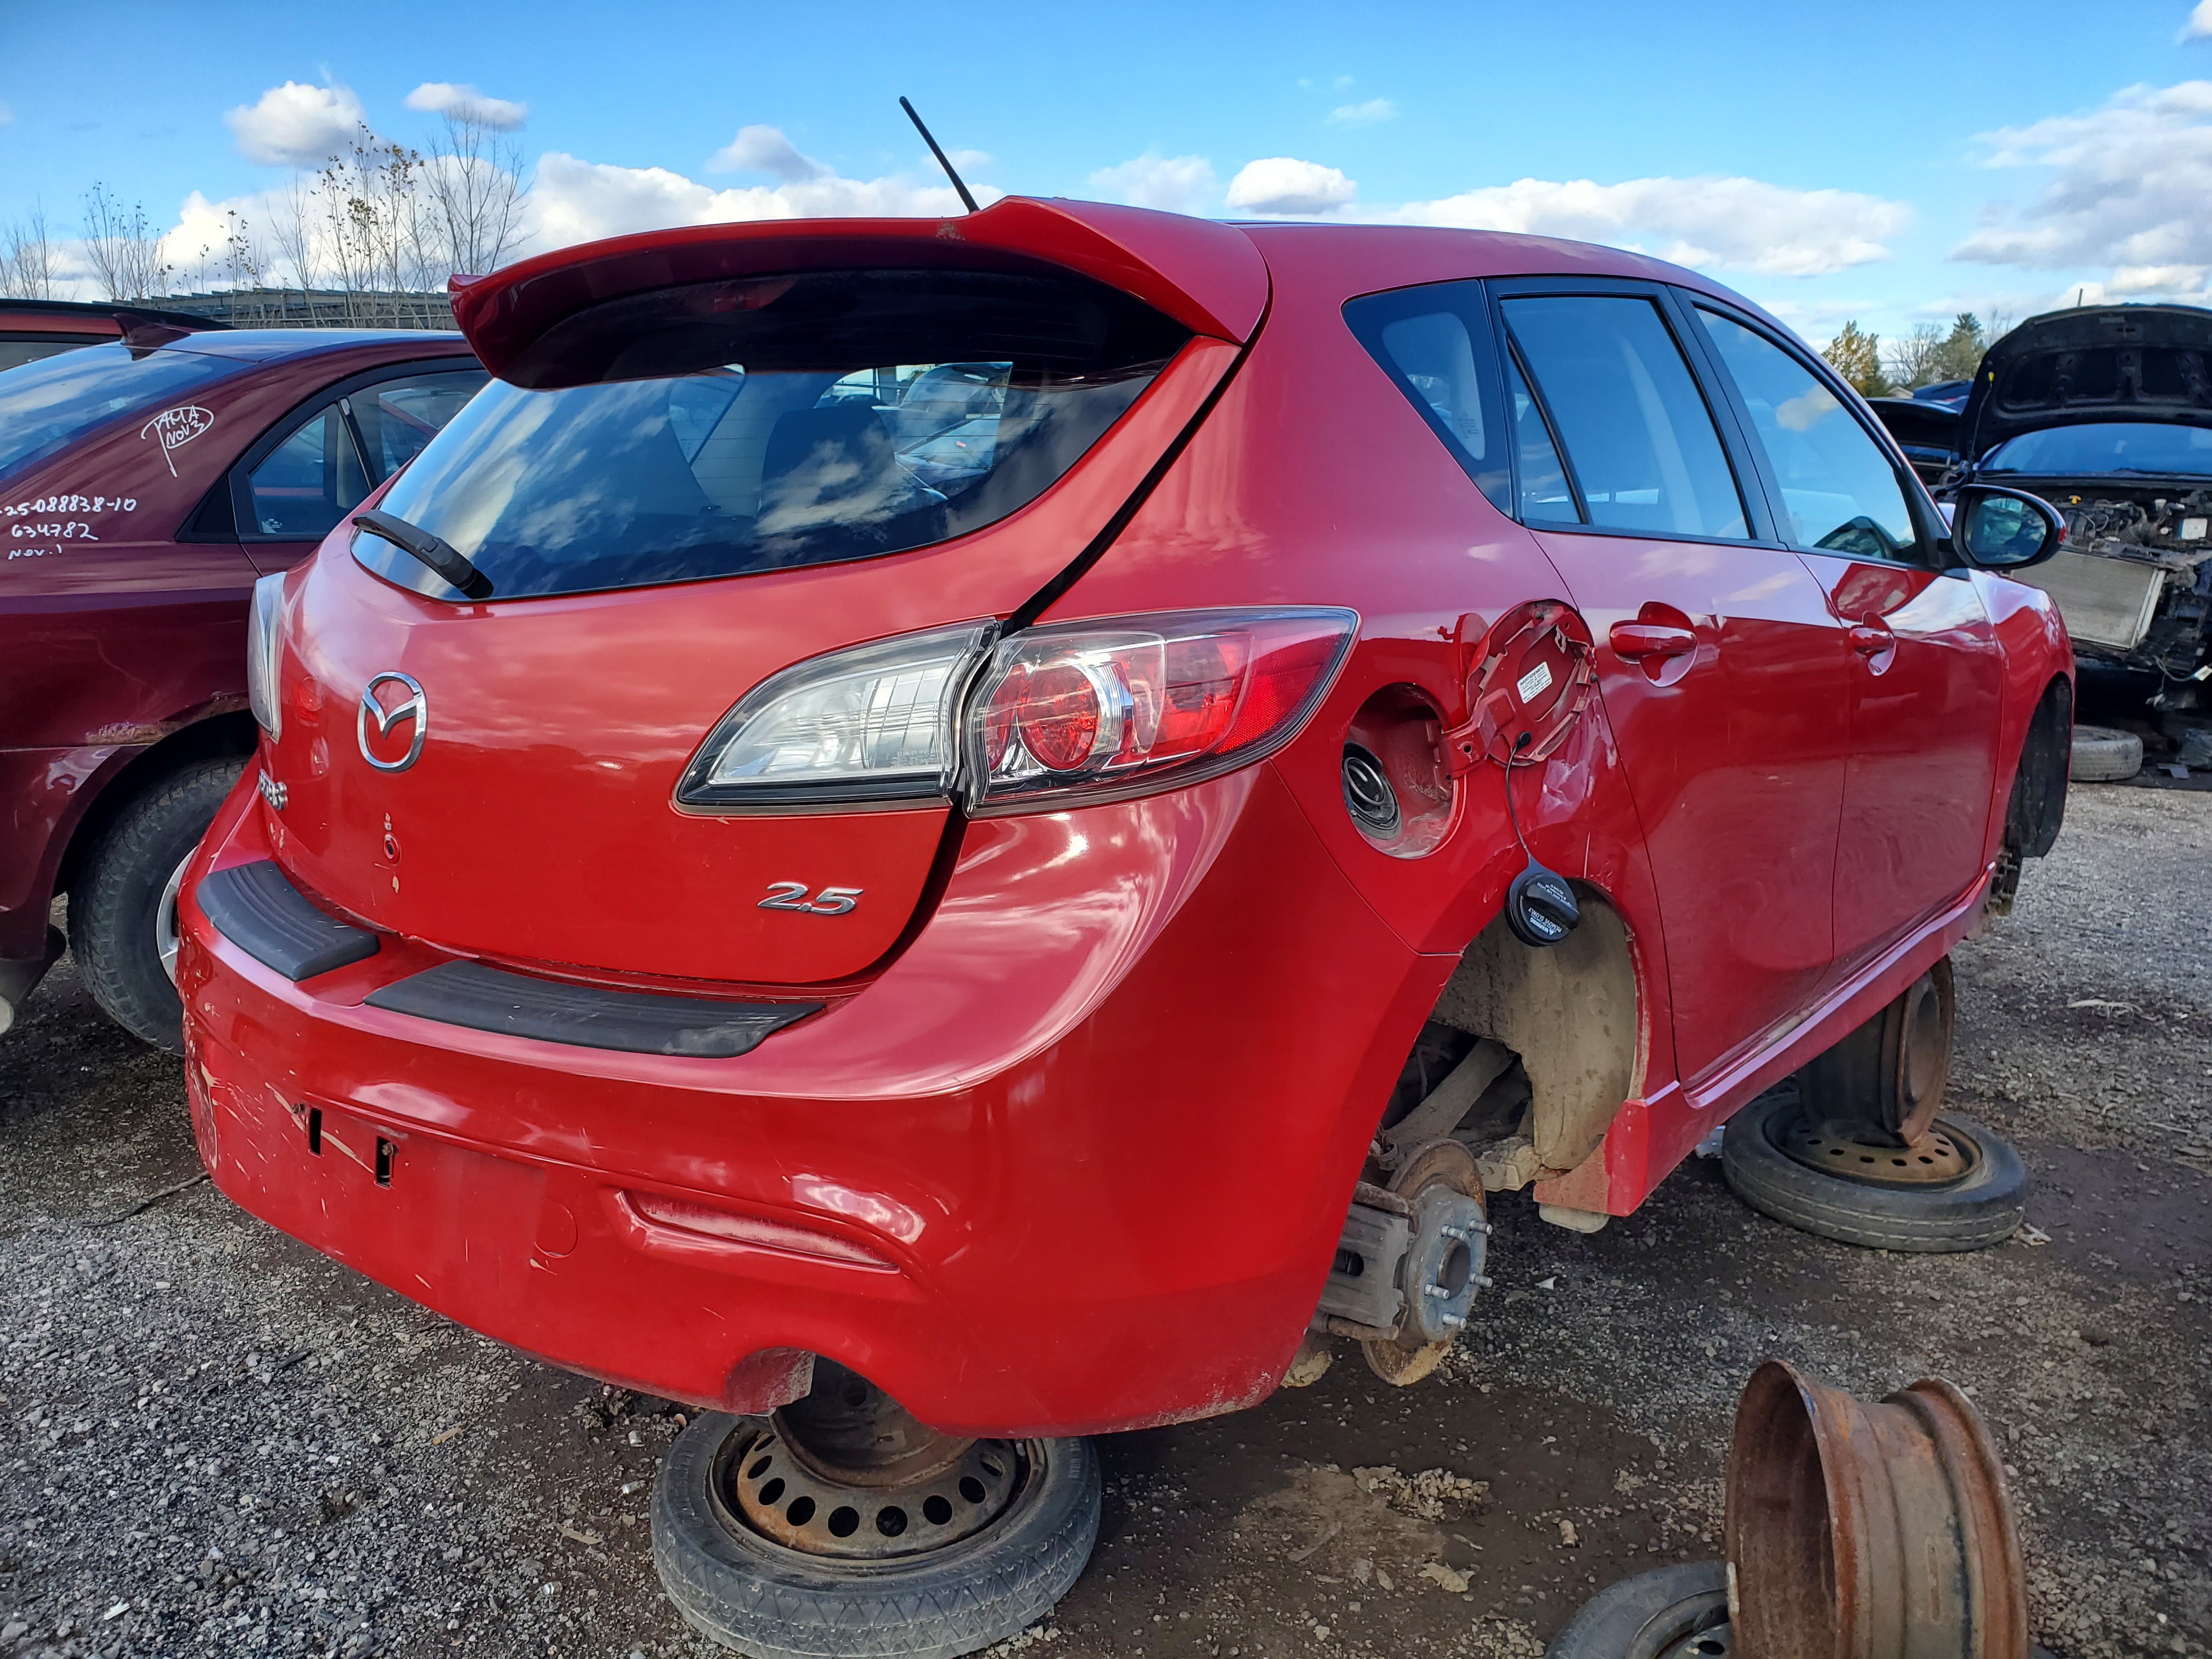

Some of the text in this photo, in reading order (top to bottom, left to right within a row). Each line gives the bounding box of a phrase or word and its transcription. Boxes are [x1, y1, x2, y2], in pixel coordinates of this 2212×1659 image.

[166, 424, 190, 445] NOV
[11, 521, 99, 540] 634782
[757, 881, 864, 915] 2.5
